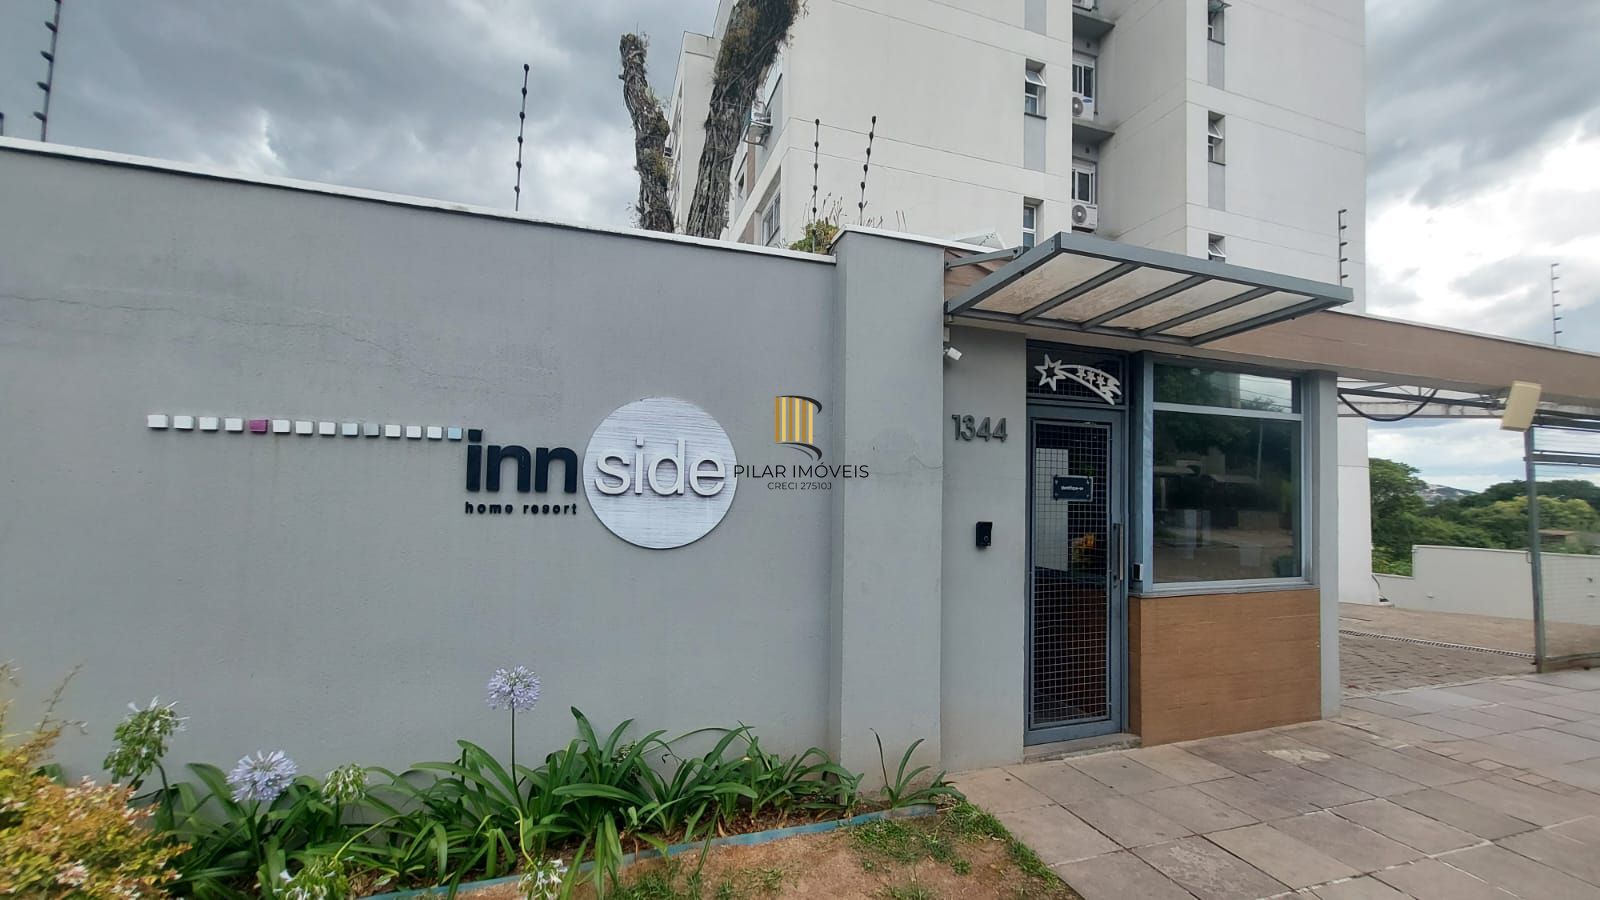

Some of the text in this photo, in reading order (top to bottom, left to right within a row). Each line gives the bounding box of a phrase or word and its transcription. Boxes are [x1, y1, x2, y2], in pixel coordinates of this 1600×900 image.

[951, 414, 1008, 443] 1344
[465, 502, 577, 515] home resort
